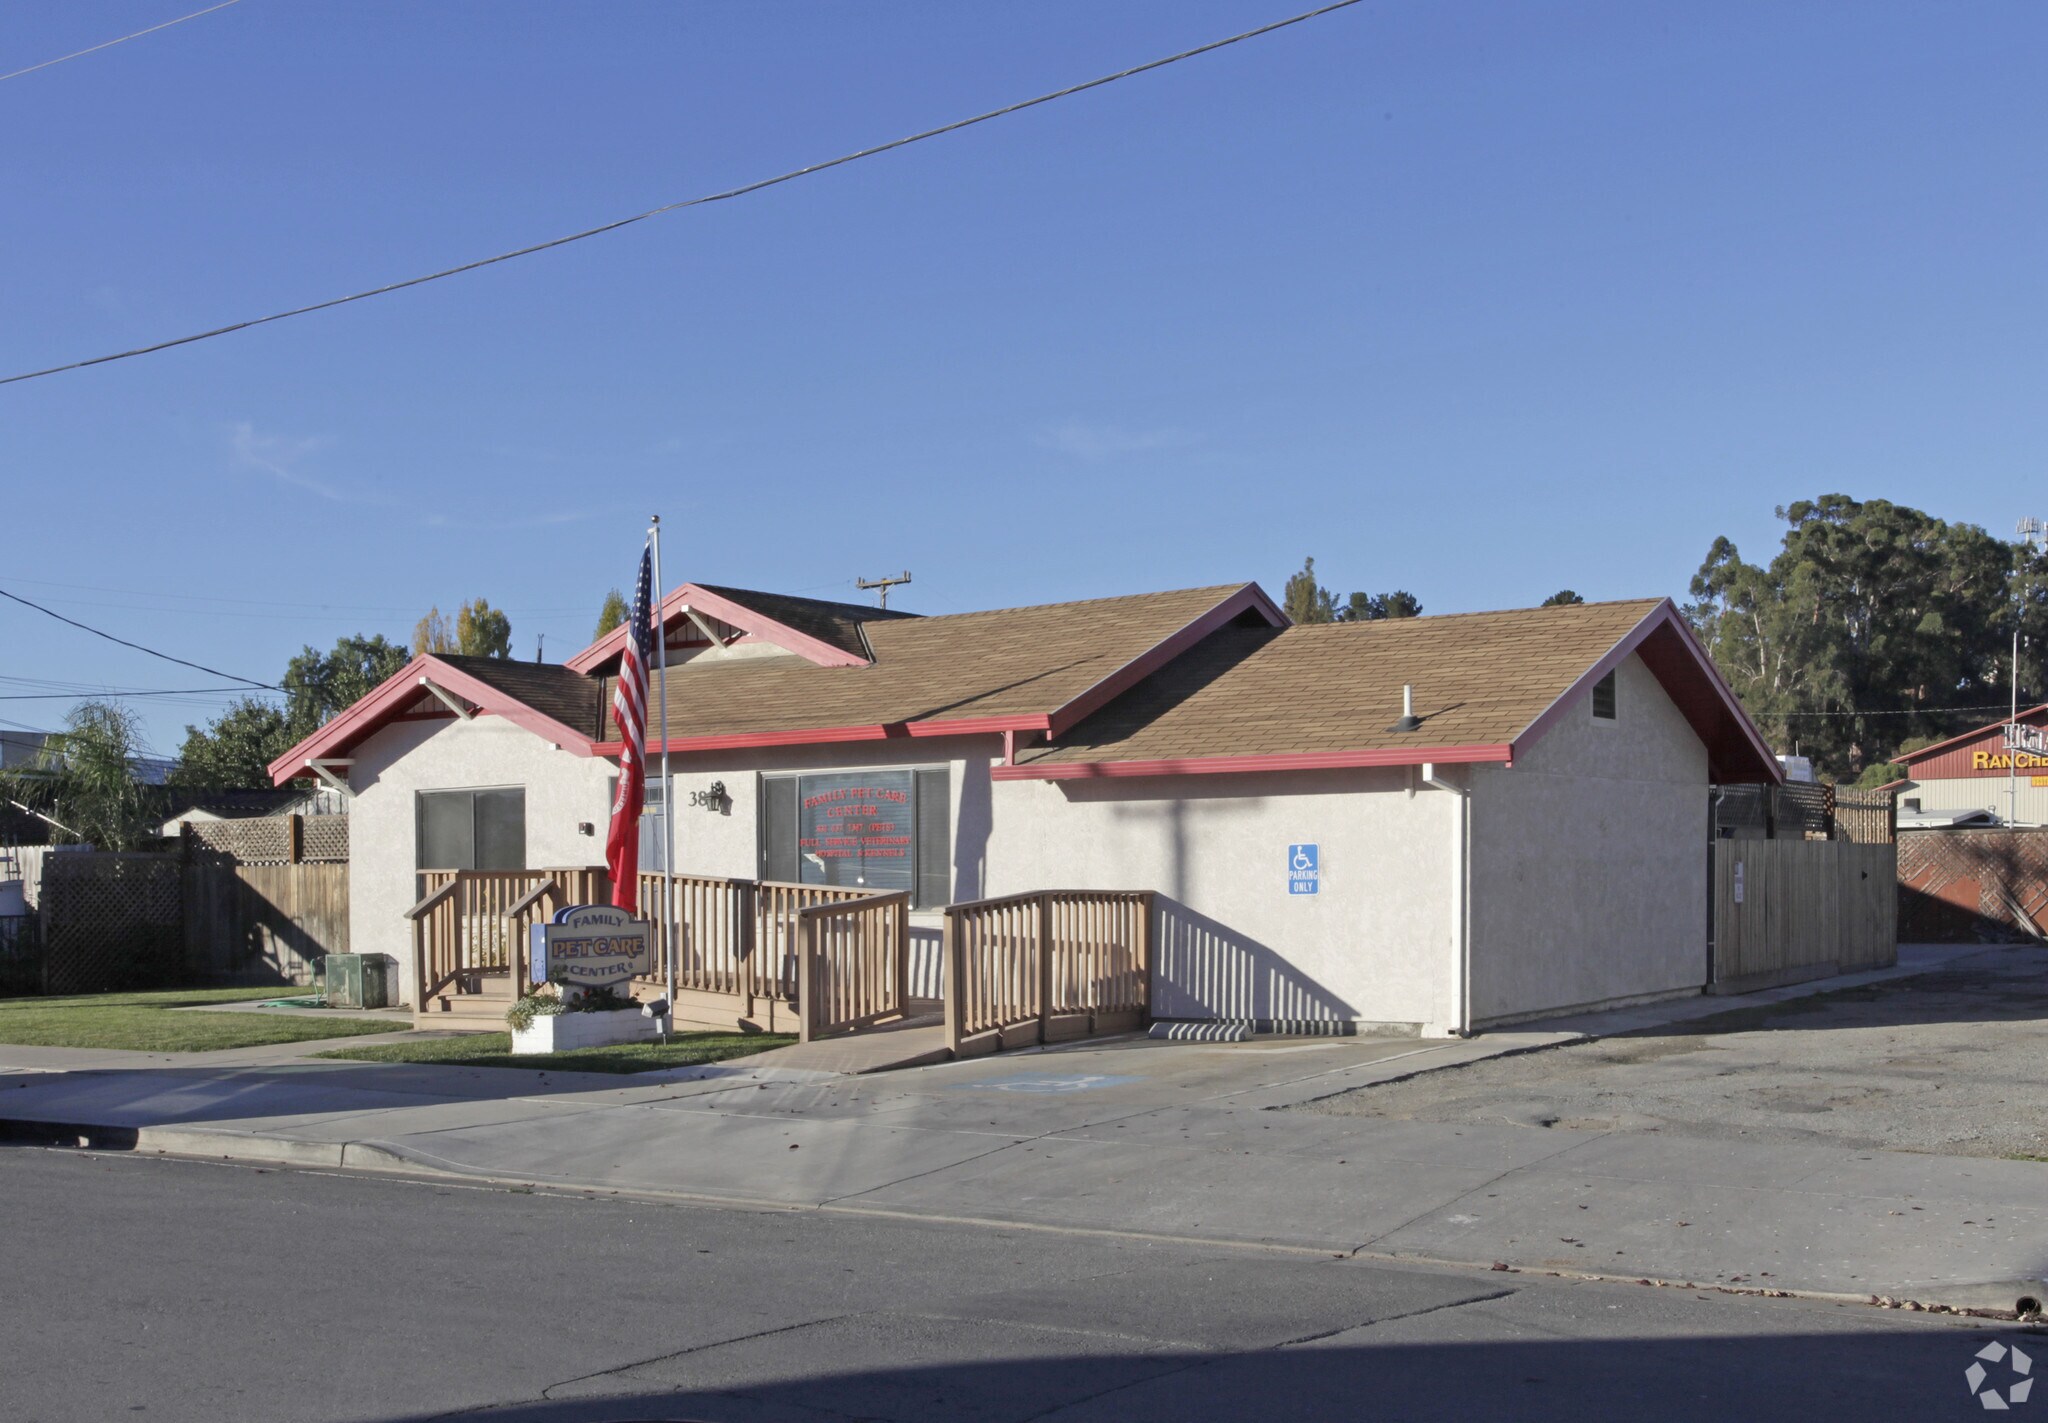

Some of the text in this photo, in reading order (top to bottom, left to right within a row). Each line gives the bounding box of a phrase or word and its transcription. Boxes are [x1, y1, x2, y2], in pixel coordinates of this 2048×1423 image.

[804, 788, 846, 809] FAMILY
[851, 787, 875, 799] PET
[827, 804, 879, 818] CENTER
[1289, 870, 1318, 881] PARKING
[1293, 881, 1313, 892] ONLY
[573, 914, 624, 929] FAMILY
[552, 937, 645, 959] PET CARE
[569, 962, 628, 977] CENTER
